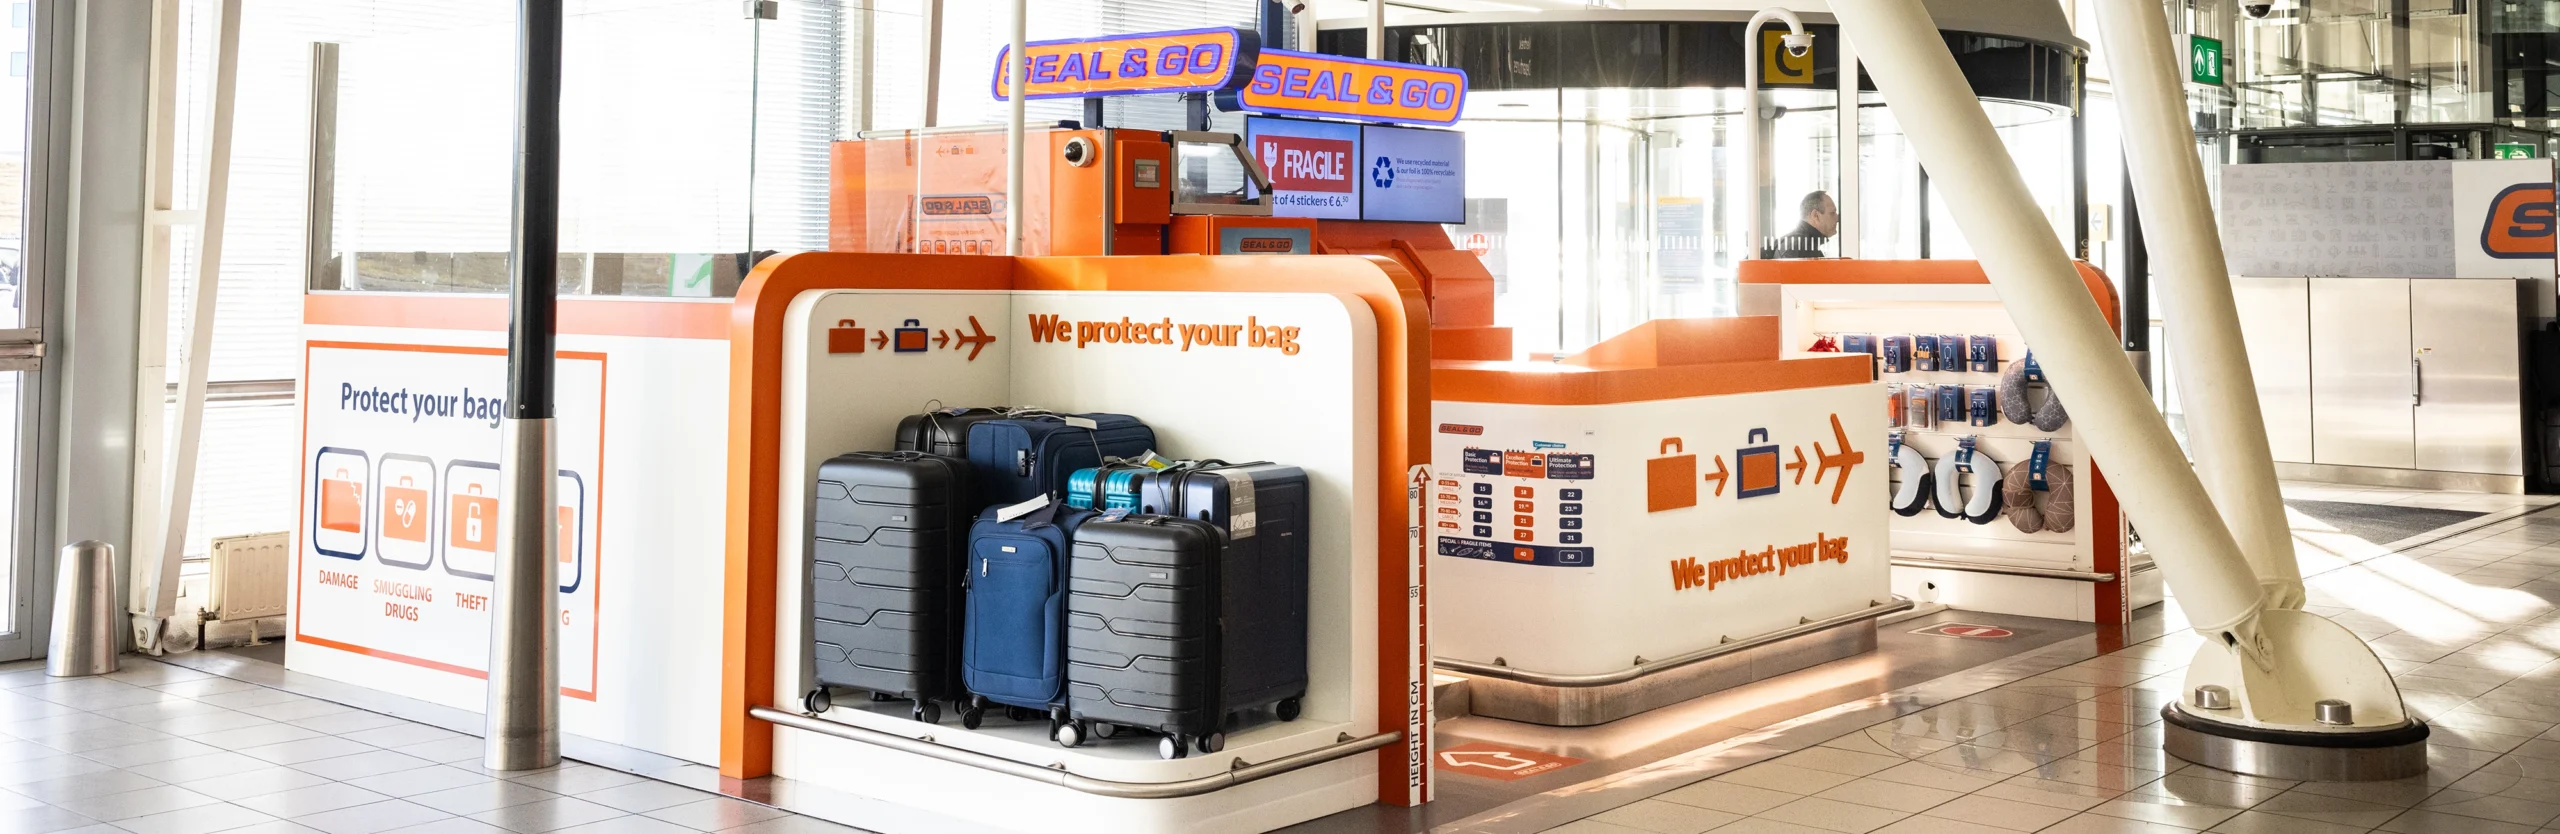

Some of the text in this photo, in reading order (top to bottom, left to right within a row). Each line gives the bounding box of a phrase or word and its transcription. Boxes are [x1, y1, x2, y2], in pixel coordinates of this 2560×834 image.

[1118, 48, 1148, 78] &
[1155, 43, 1223, 76] GO
[1251, 64, 1456, 111] SEAL & GO
[1283, 148, 1345, 181] FRAGILE
[1396, 157, 1404, 165] We
[1412, 159, 1432, 167] recycled
[1433, 169, 1456, 178] recyclable
[1279, 194, 1289, 205] of
[1289, 194, 1295, 205] 4
[1296, 194, 1328, 207] stickers
[1329, 195, 1334, 206] €
[1242, 241, 1290, 249] SEAL & GO
[1028, 313, 1301, 356] We protect your bag
[341, 382, 408, 415] Protect
[412, 393, 458, 423] your
[1505, 459, 1529, 467] Protection
[1409, 490, 1418, 500] 80
[1409, 529, 1418, 539] 70
[1670, 532, 1849, 591] We protect your bag
[319, 569, 359, 590] DAMAGE
[373, 578, 433, 603] SMUGGLING
[1410, 588, 1419, 599] 55
[385, 601, 419, 622] DRUGS
[455, 592, 488, 612] THEFT
[1411, 680, 1419, 788] HEIGHT IN CM
